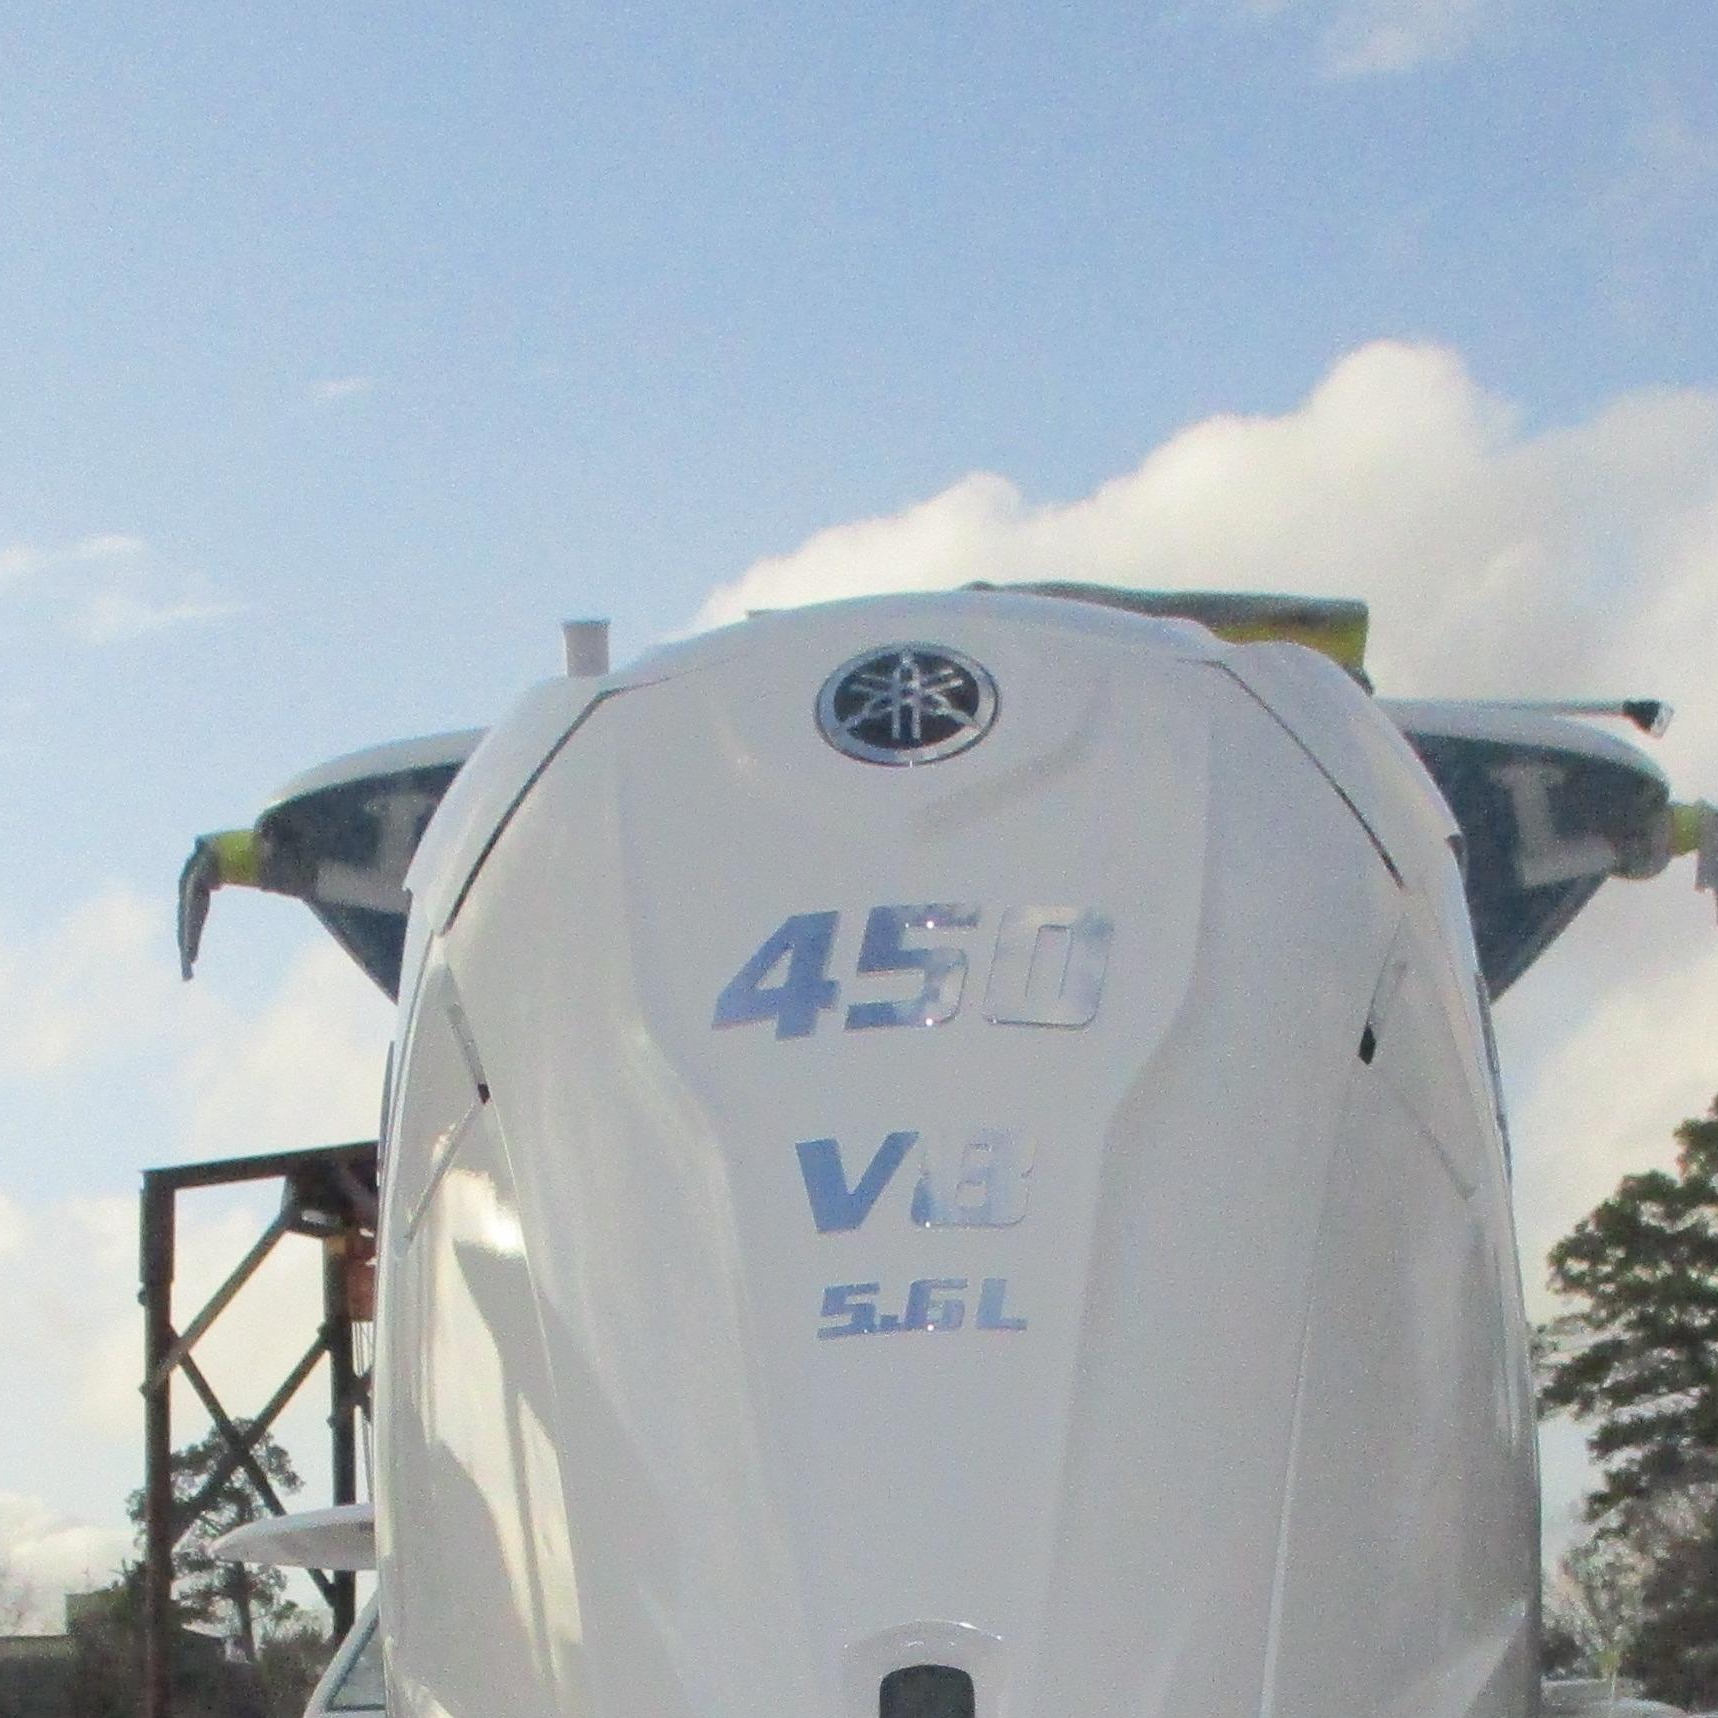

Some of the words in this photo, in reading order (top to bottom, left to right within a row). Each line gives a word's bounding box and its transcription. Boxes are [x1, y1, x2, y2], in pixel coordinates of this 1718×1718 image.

[710, 903, 1115, 1041] 450
[794, 1131, 1036, 1235] V8
[817, 1276, 1027, 1341] 5.6L
